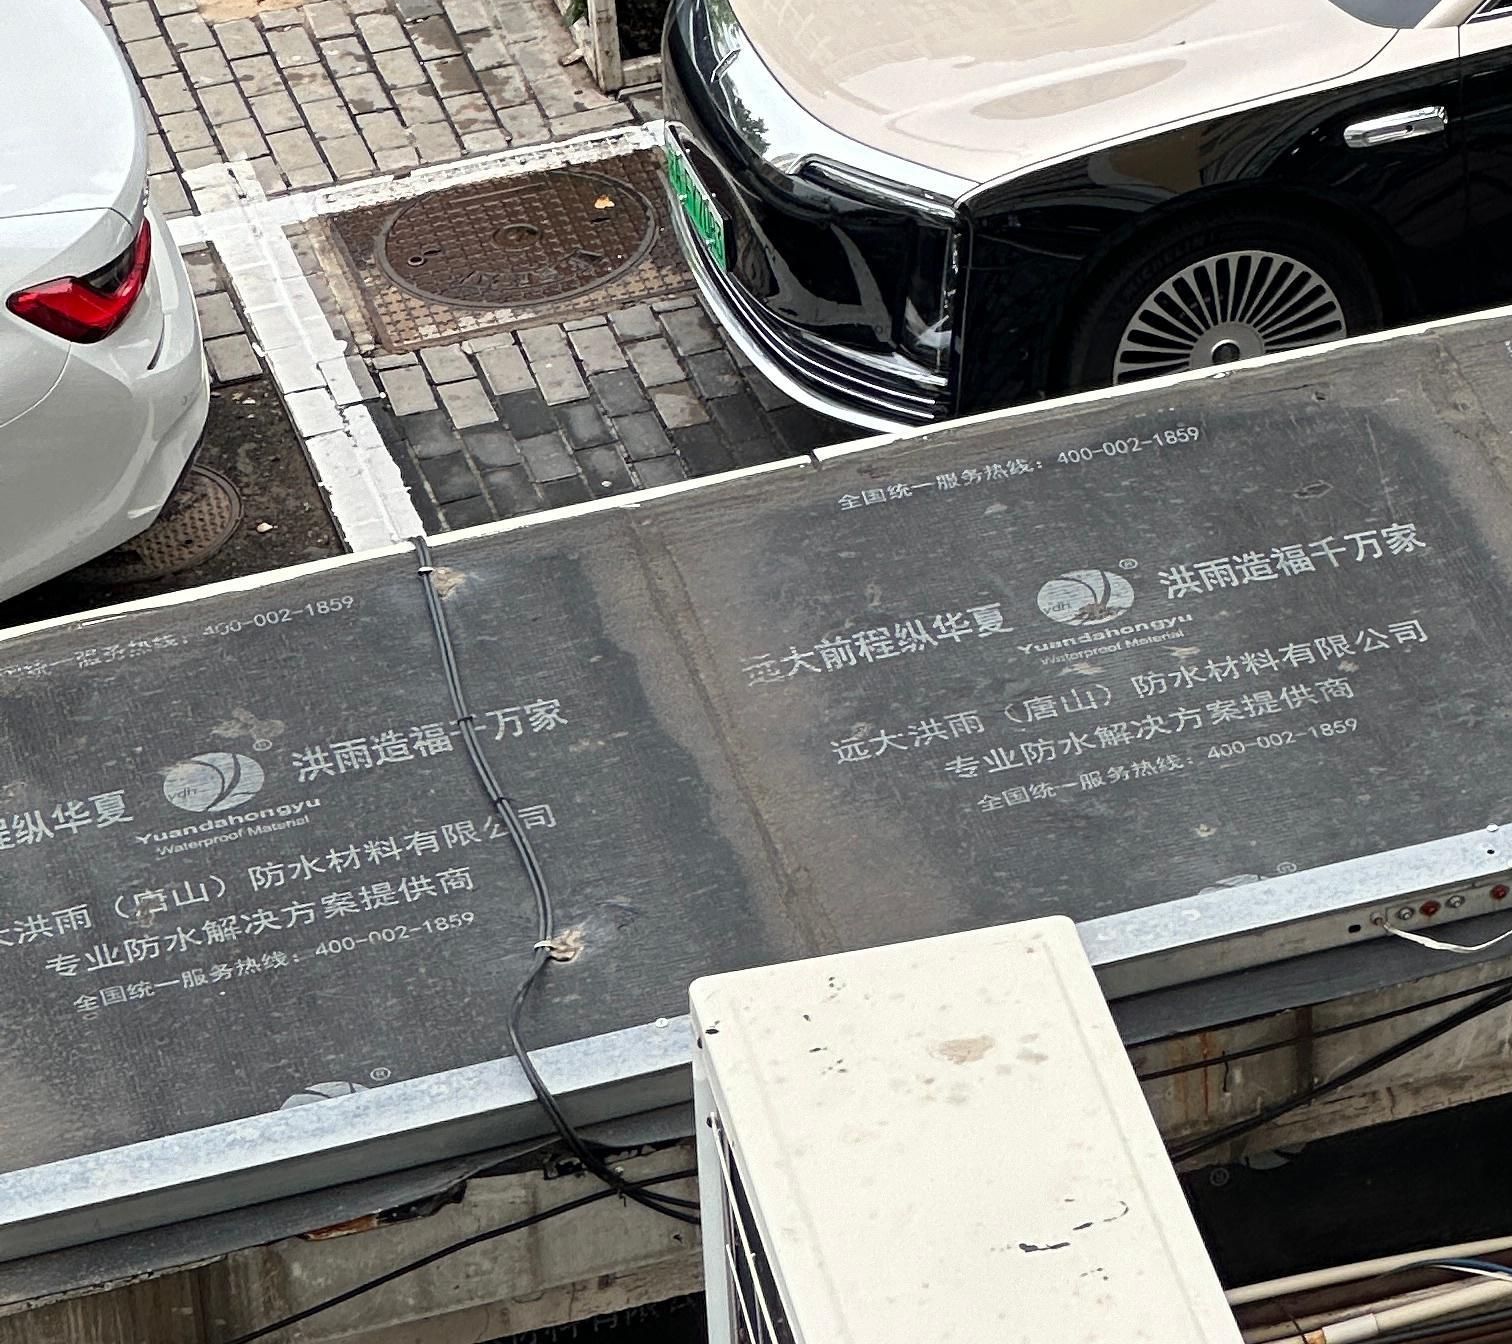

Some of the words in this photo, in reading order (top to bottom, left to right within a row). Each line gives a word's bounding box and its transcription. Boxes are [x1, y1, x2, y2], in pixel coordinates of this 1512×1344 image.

[1158, 522, 1427, 600] 洪雨造福千万家
[1017, 613, 1194, 656] Yuandahongyu
[944, 677, 1354, 779] 专业防水解决方案提供商
[135, 798, 322, 846] Yuandahongyu
[45, 866, 475, 978] 专业防水解决方案提供商
